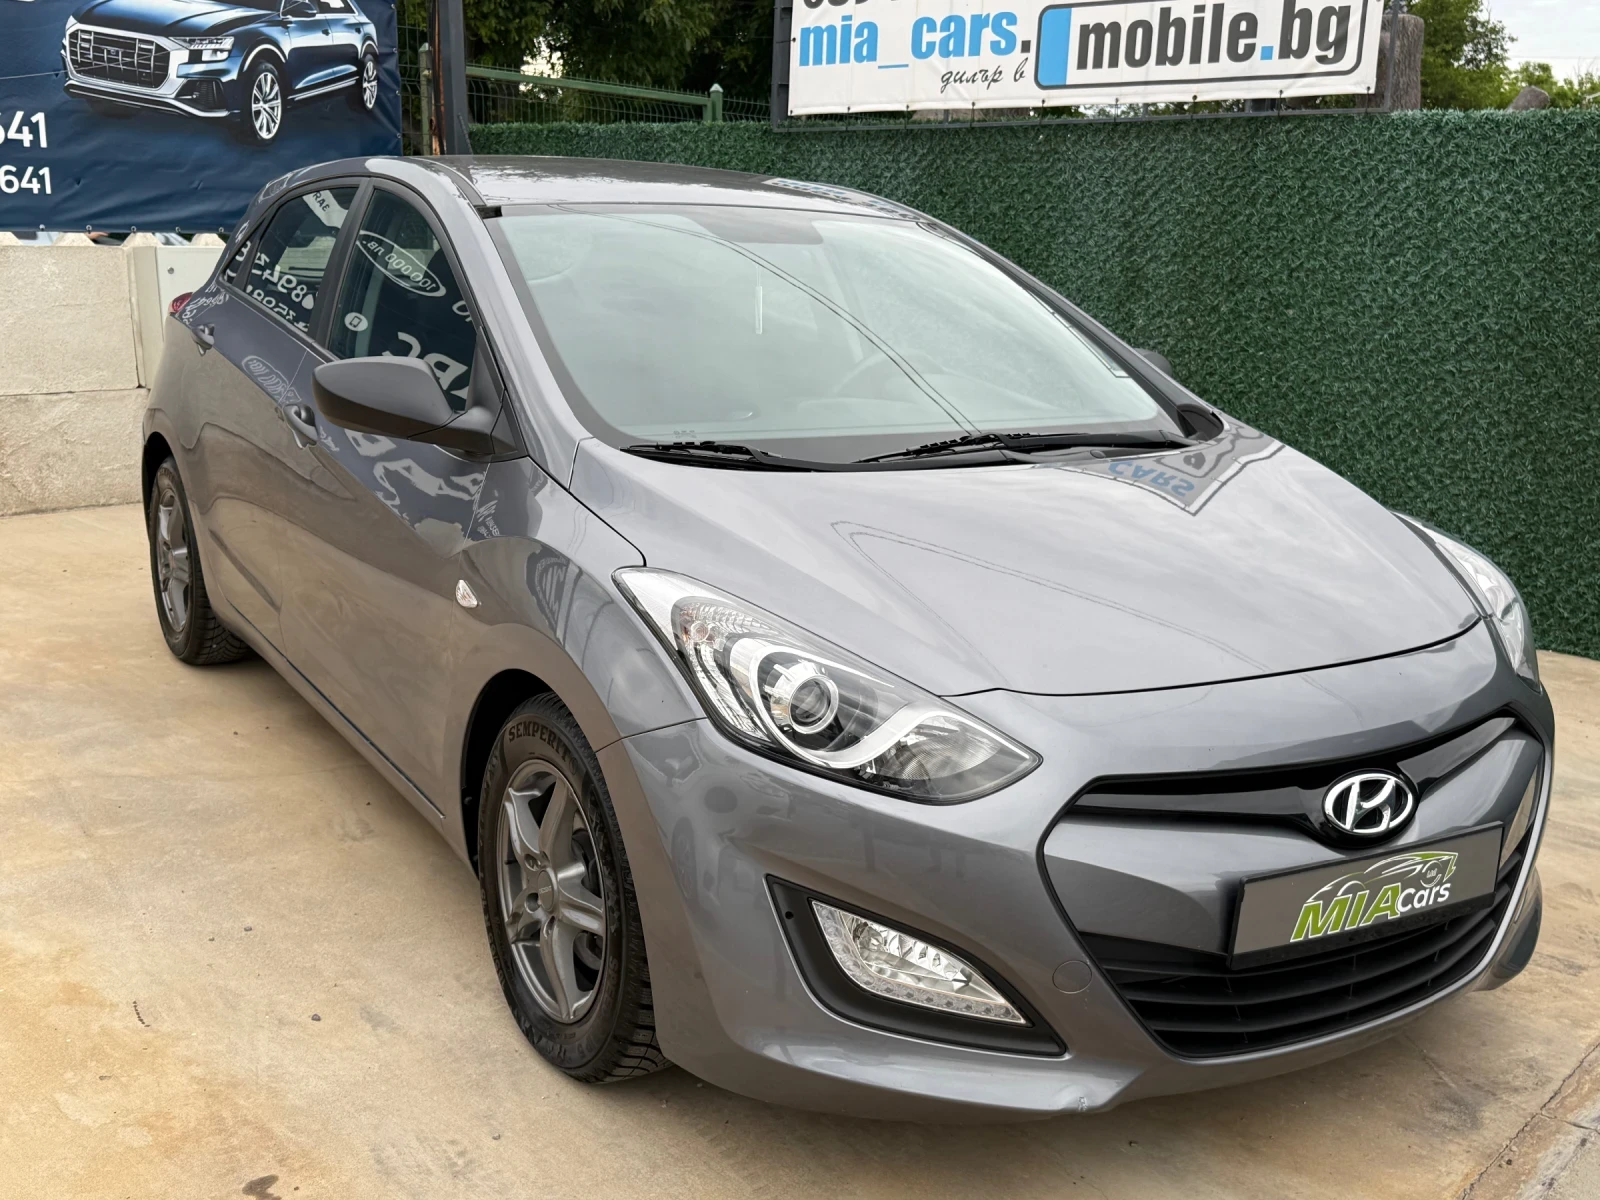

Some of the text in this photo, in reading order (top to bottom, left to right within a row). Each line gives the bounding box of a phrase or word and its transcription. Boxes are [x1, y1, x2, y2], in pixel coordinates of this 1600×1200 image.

[1076, 0, 1351, 66] mobile.bg
[940, 65, 1003, 94] дилър
[0, 111, 47, 148] 41
[0, 165, 52, 194] 641
[508, 720, 571, 762] SEMPERIT
[1290, 882, 1401, 942] MIA
